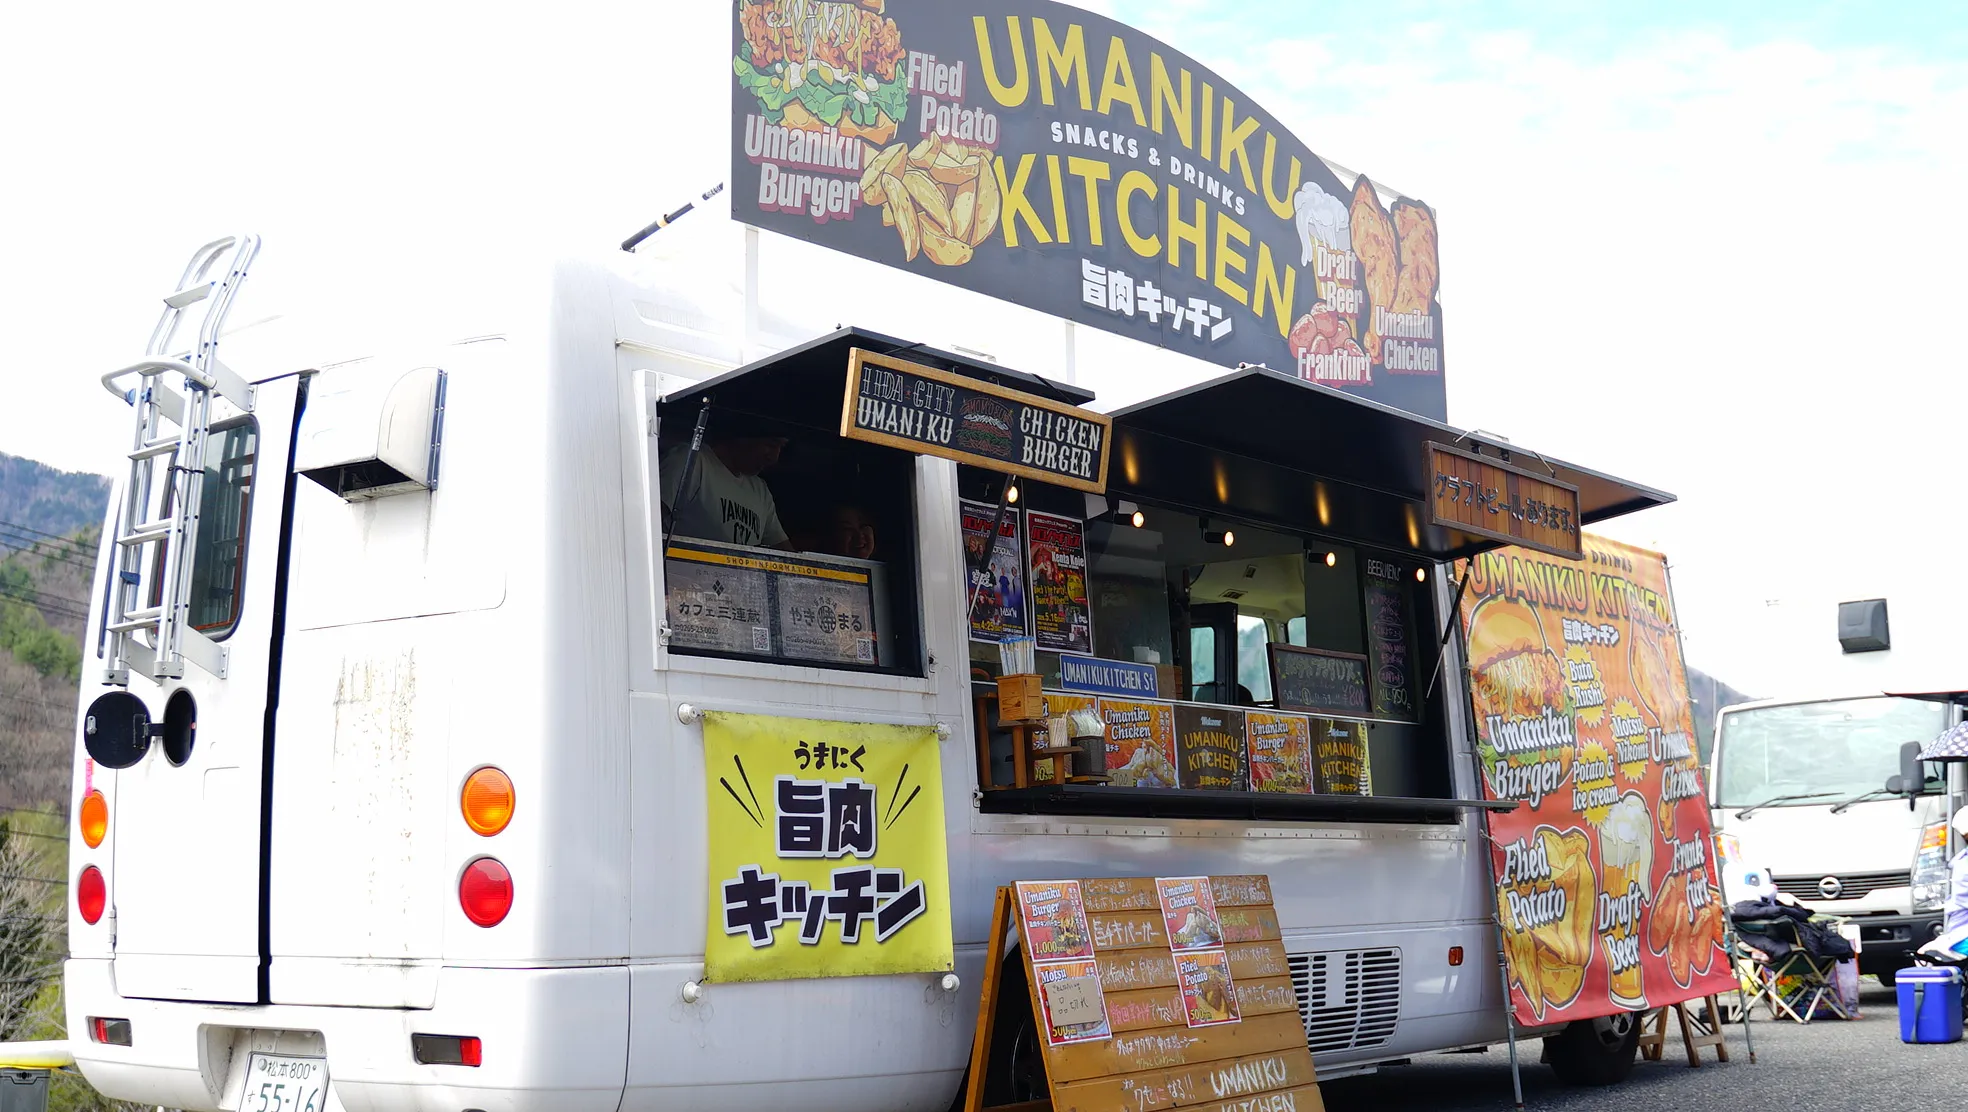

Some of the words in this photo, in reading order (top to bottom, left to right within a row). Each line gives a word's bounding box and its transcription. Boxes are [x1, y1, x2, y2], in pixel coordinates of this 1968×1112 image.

[908, 51, 963, 98] Flied
[919, 95, 998, 146] Potato
[973, 15, 1301, 220] UMANIKU
[745, 113, 862, 172] Umaniku
[1051, 120, 1139, 159] SNACKS
[1148, 147, 1162, 168] &
[1170, 155, 1246, 216] DRINKS
[759, 162, 862, 218] Burger
[996, 151, 1297, 340] KITCHEN
[1316, 247, 1357, 283] Draft
[1081, 258, 1234, 346] 旨肉キッチン
[1325, 281, 1364, 316] Beer
[1375, 305, 1434, 341] Umaniku
[1297, 346, 1373, 384] Frankfurt
[1383, 337, 1438, 373] Chicken
[912, 379, 956, 415] CITY
[857, 395, 954, 445] UMANIKU
[1019, 406, 1101, 452] CHICKEN
[1020, 434, 1093, 479] BURGER
[726, 556, 751, 566] SHOP
[752, 559, 819, 576] INFORMATION
[1590, 549, 1632, 573] DRINKS
[1469, 552, 1588, 614] UMANIKU
[1590, 571, 1671, 632] KITCHEN
[1562, 617, 1620, 648] 旨肉キッチン
[1144, 673, 1155, 692] St
[1568, 659, 1594, 682] Buta
[1104, 706, 1150, 724] Umaniku
[1111, 723, 1151, 740] Chicken
[1250, 718, 1288, 736] Umaniku
[1486, 707, 1574, 752] Umaniku
[1612, 716, 1644, 738] Motsu
[794, 740, 867, 772] うまにく
[1184, 731, 1238, 752] UMANIKU
[1256, 736, 1286, 754] Burger
[1317, 742, 1364, 760] UMANIKU
[1616, 737, 1650, 764] Nikomi
[1188, 751, 1238, 774] KITCHEN
[1320, 760, 1362, 778] KITCHEN
[1572, 759, 1604, 784] Potato
[1606, 754, 1616, 776] &
[1495, 760, 1562, 808] Burger
[1572, 788, 1588, 810] Ice
[1589, 786, 1620, 804] cream
[775, 776, 876, 857] 旨肉
[1502, 835, 1550, 886] Flied
[1672, 830, 1706, 875] Frank
[722, 864, 926, 947] キッチン
[1024, 886, 1062, 904] Umaniku
[1162, 882, 1194, 898] Umaniku
[1168, 896, 1197, 909] Chicken
[1506, 881, 1566, 932] Potato
[1686, 874, 1714, 923] furt
[1032, 902, 1060, 918] Burger
[1598, 882, 1642, 935] Draft
[1180, 960, 1198, 974] Flied
[1605, 935, 1640, 974] Beer
[1040, 968, 1068, 984] Motsu
[1184, 972, 1208, 986] Potato
[1210, 1056, 1286, 1097] UMANIKU
[256, 1082, 319, 1112] 55-16
